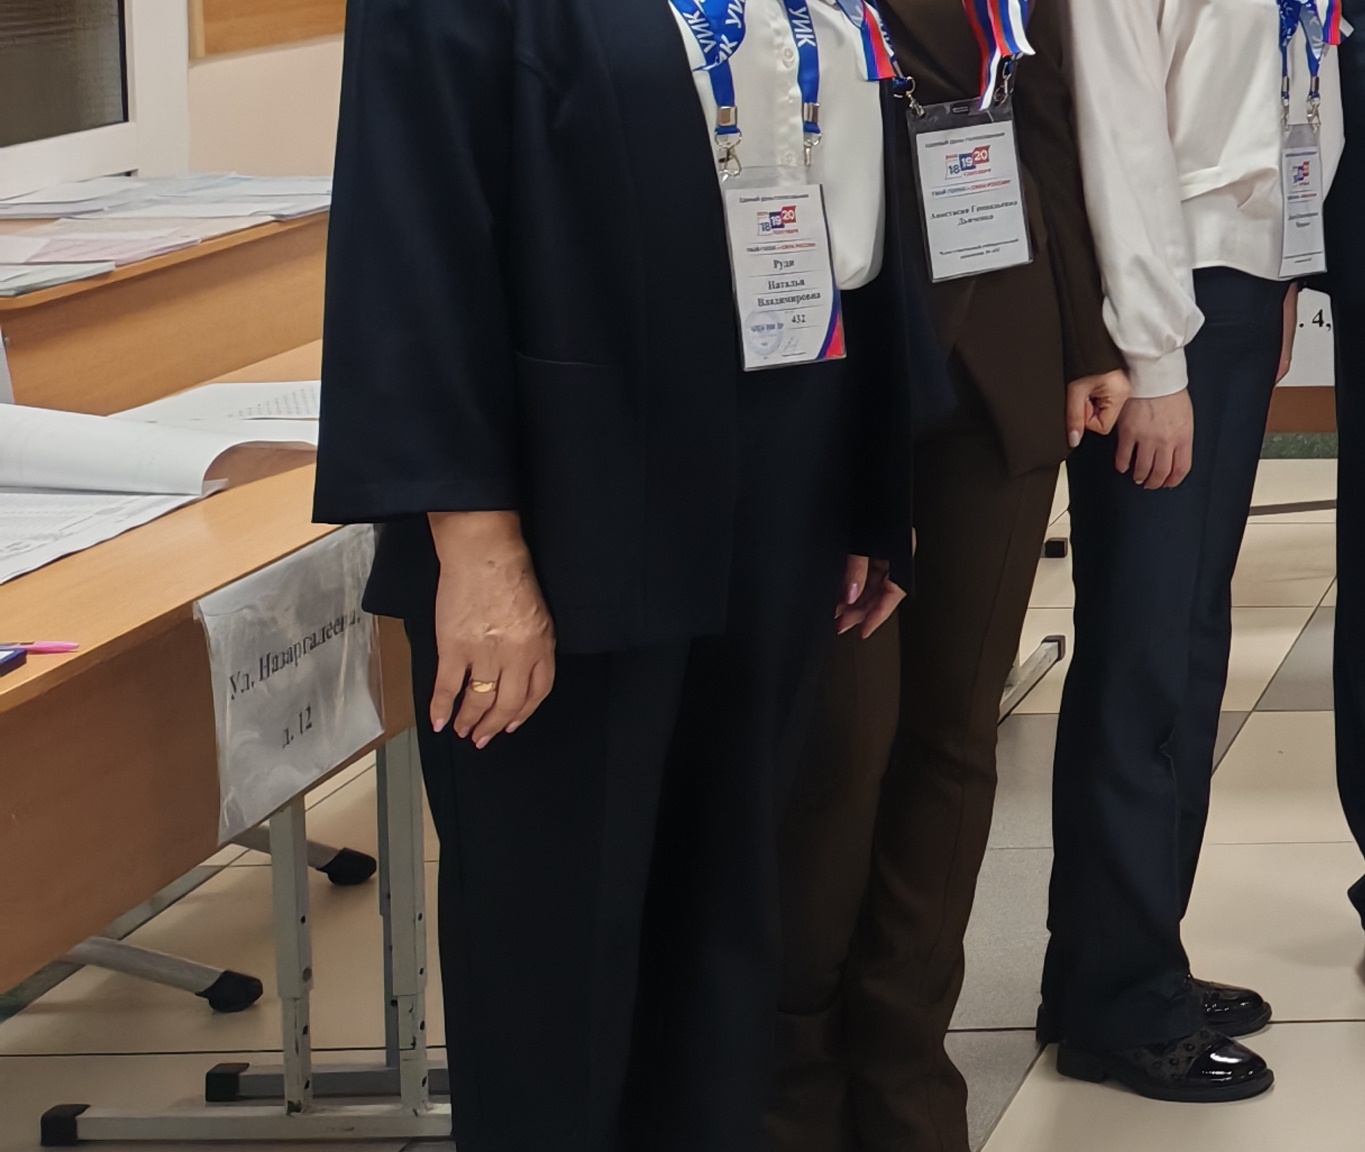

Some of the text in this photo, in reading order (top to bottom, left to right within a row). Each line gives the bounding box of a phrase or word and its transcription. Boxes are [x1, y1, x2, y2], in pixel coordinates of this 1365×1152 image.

[789, 6, 816, 47] УИК
[973, 149, 988, 161] 20
[961, 157, 973, 168] 19
[782, 209, 795, 221] 20
[299, 704, 313, 735] 12
